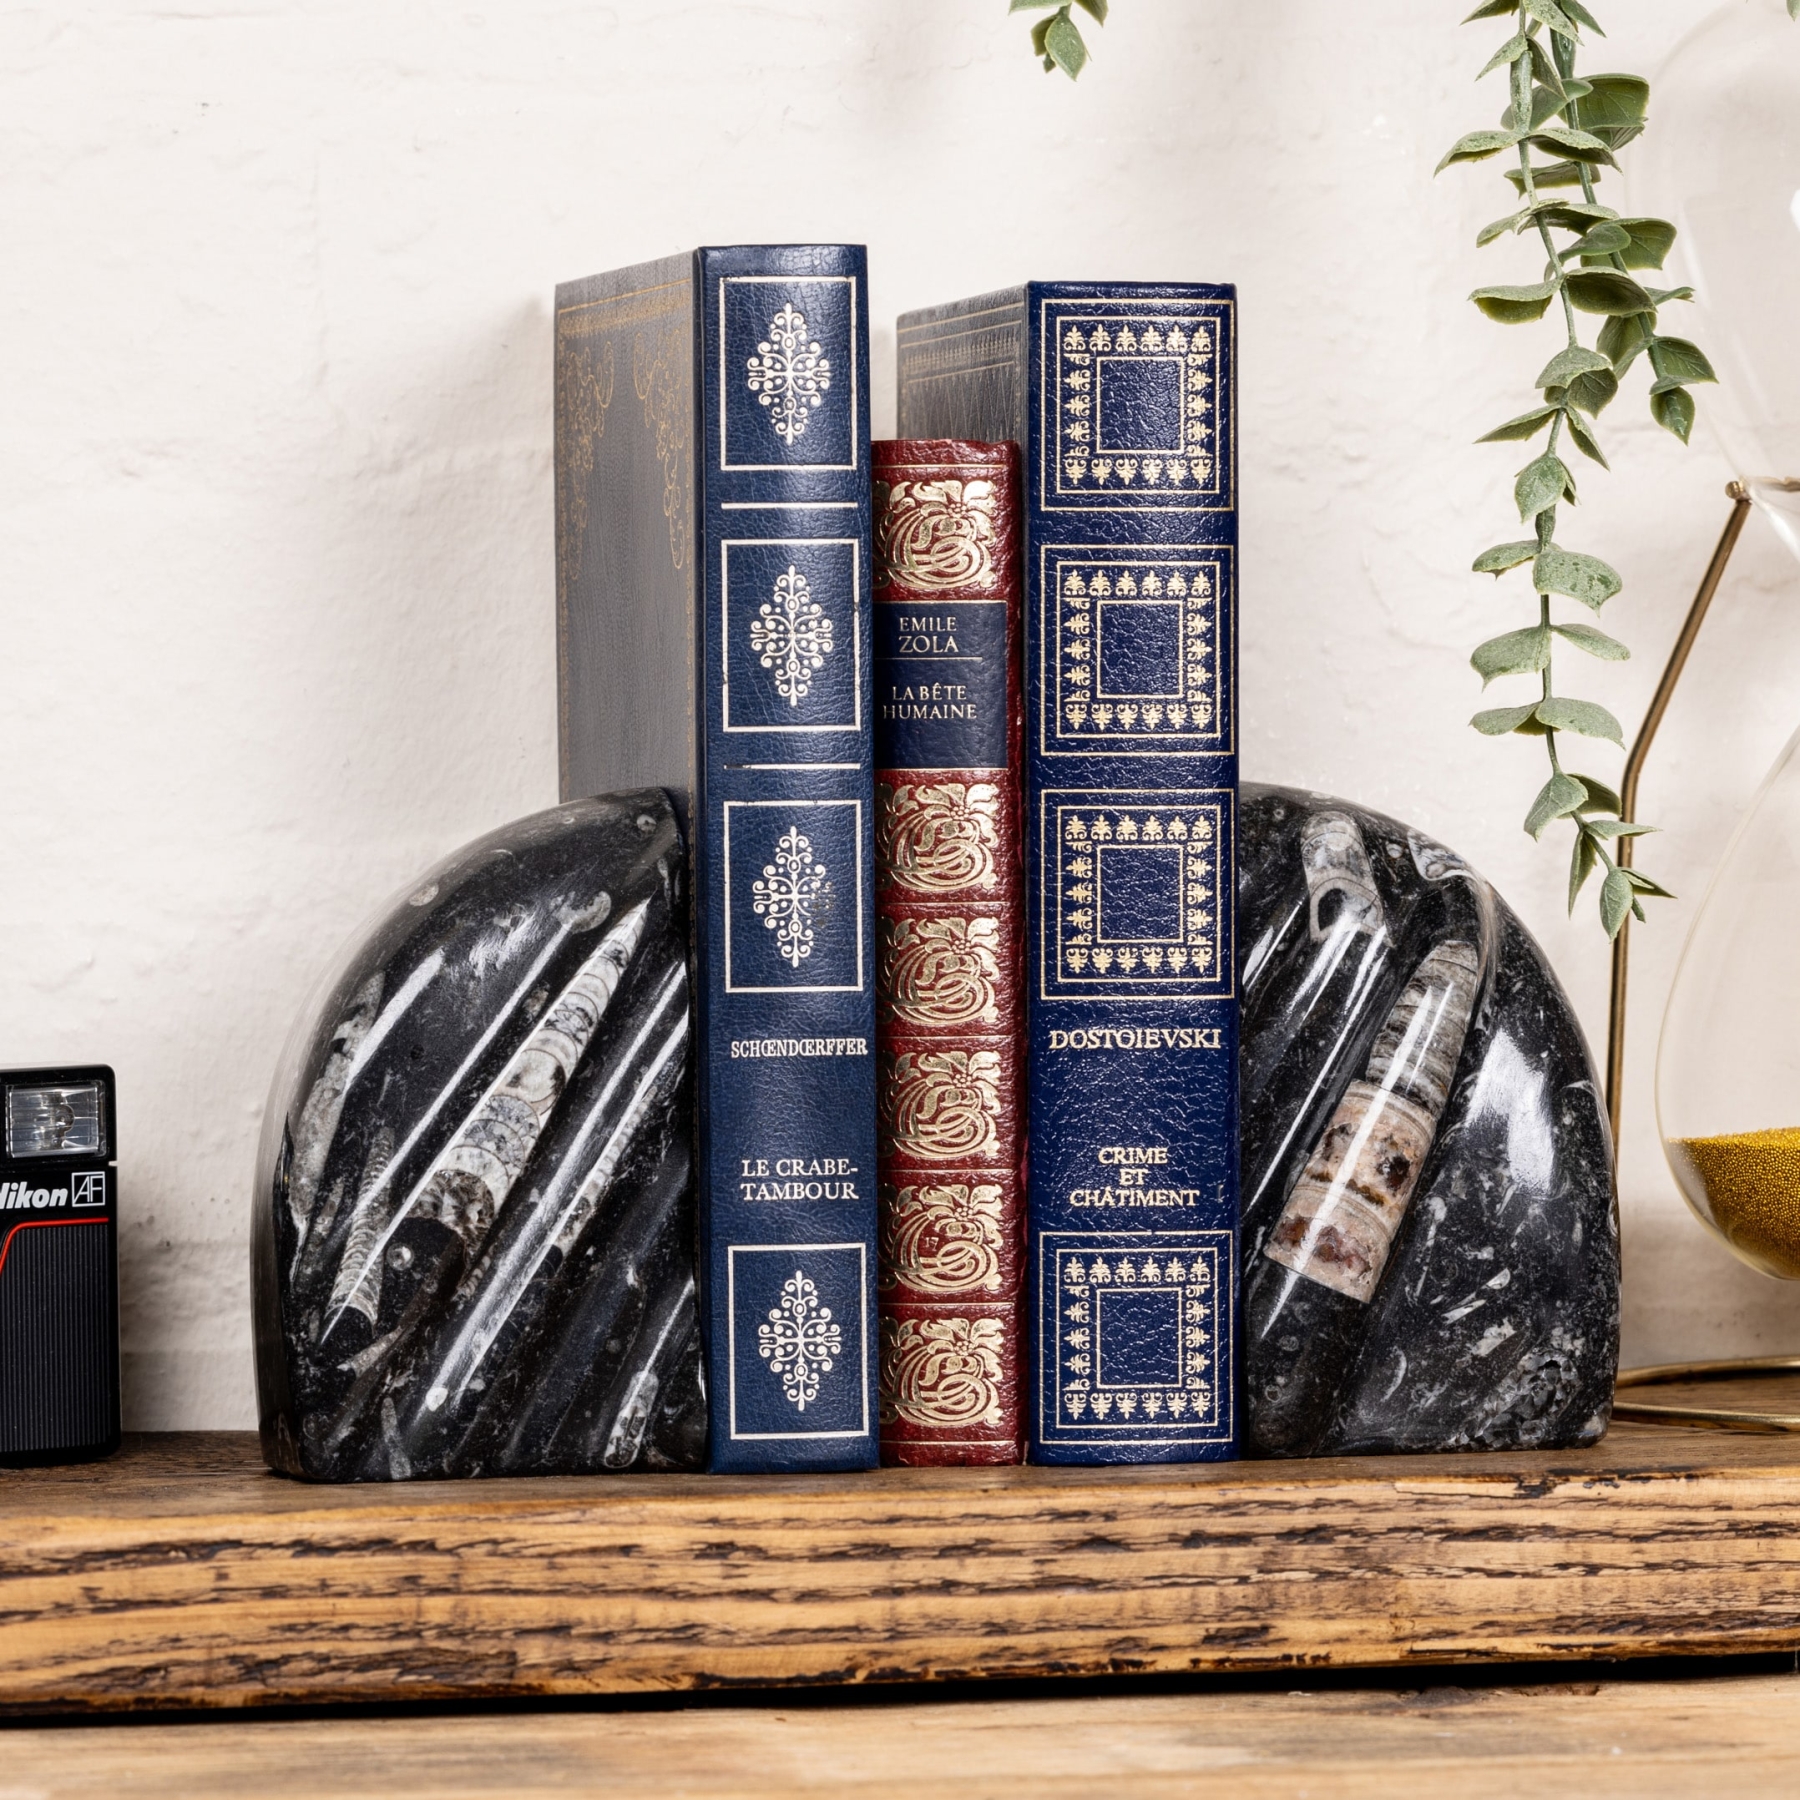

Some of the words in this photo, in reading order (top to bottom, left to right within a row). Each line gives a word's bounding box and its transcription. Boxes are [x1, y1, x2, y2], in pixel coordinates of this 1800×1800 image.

[899, 616, 957, 632] EMILE
[898, 634, 959, 653] ZOLA
[892, 686, 915, 701] LA
[919, 682, 967, 701] BÊTE
[883, 704, 977, 719] HUMAINE
[1098, 1147, 1168, 1165] CRIME
[742, 1159, 769, 1177] LE
[775, 1158, 859, 1177] CRABE-
[1119, 1168, 1149, 1186] ET
[73, 1174, 104, 1203] AF
[740, 1182, 859, 1201] TAMBOUR
[1069, 1186, 1200, 1207] CHÂTIMENT
